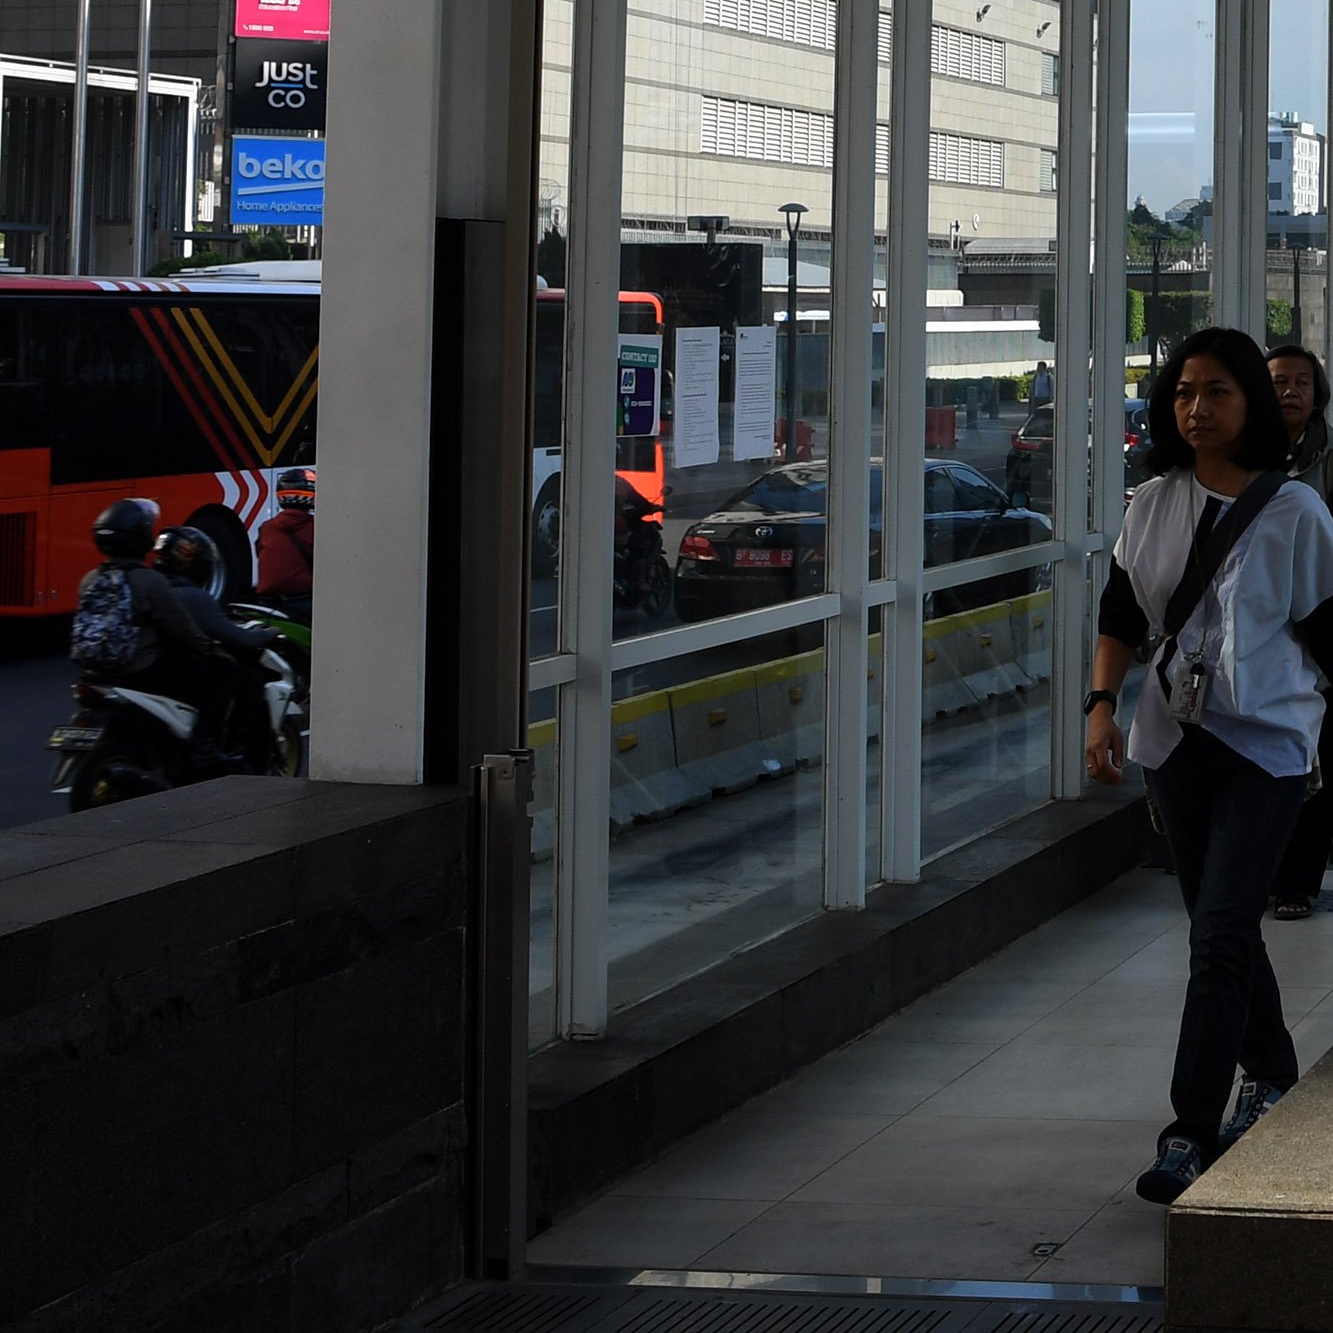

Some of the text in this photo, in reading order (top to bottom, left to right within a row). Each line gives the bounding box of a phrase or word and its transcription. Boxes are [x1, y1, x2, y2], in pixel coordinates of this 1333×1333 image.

[238, 152, 325, 180] beko
[237, 200, 324, 213] Home Appliances
